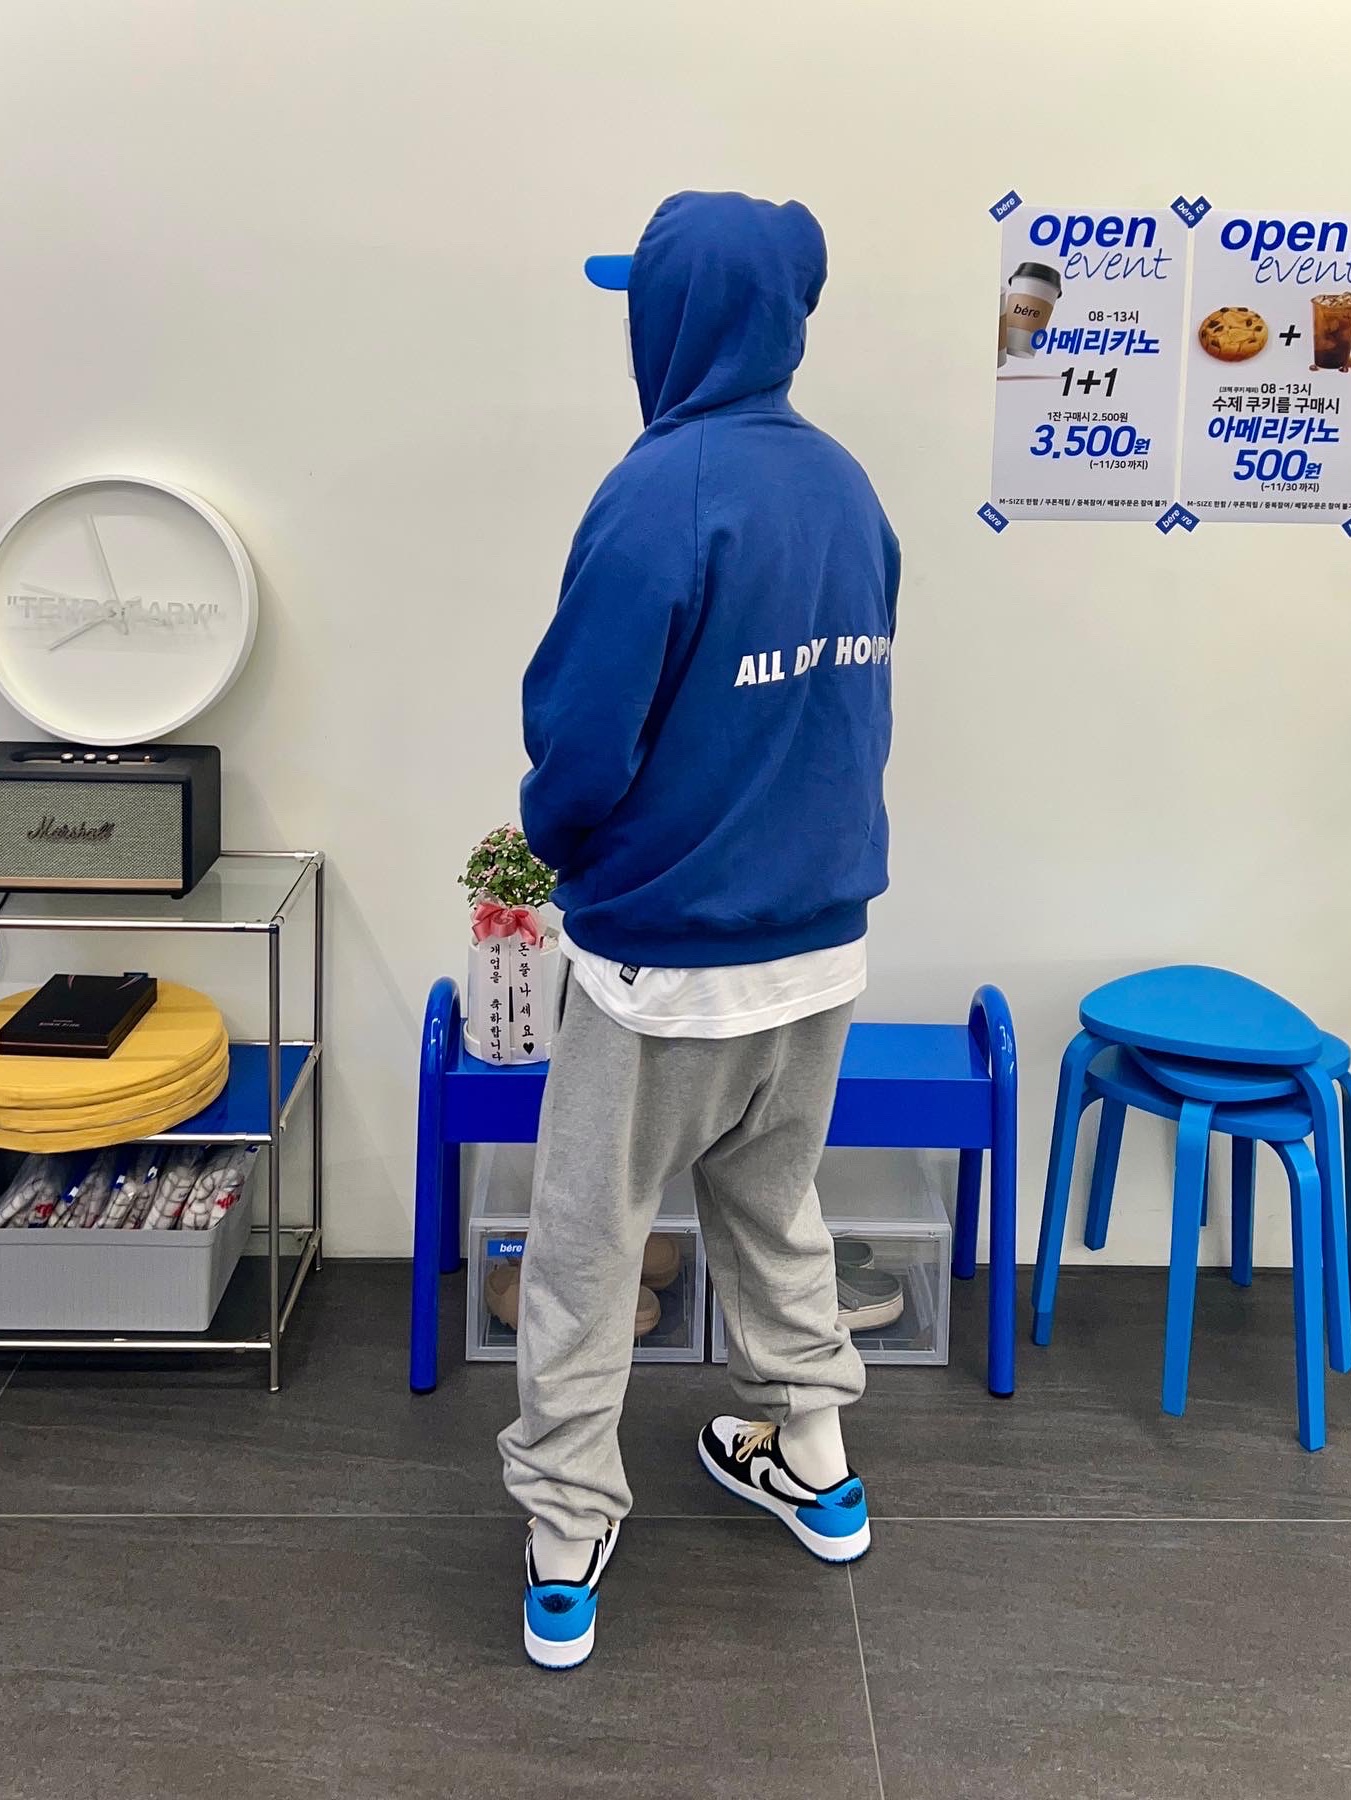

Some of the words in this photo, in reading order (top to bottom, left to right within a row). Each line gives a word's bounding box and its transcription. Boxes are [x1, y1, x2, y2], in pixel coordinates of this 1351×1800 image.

[1195, 203, 1205, 214] re
[1029, 214, 1157, 257] open
[1221, 218, 1348, 261] open
[1064, 248, 1173, 280] event
[1255, 256, 1351, 284] even
[1031, 327, 1160, 356] 아메리카노
[1061, 367, 1118, 397] 1+1
[1047, 412, 1061, 422] 1잔
[1063, 411, 1091, 422] 구매시
[1092, 412, 1128, 422] 2.500원
[1212, 395, 1243, 412] 수제
[1246, 396, 1291, 414] 쿠키를
[1294, 397, 1340, 415] 구매시
[1030, 424, 1151, 459] 3.500원
[1208, 415, 1340, 445] 아메리카노
[1127, 460, 1149, 470] 까지)
[1233, 449, 1322, 482] 500원
[1299, 482, 1320, 493] 까지)
[1187, 500, 1213, 508] M-SIZE
[734, 650, 785, 688] ALL
[27, 815, 116, 841] Marshall
[490, 943, 502, 984] 개업을
[490, 998, 503, 1062] 축하합니다
